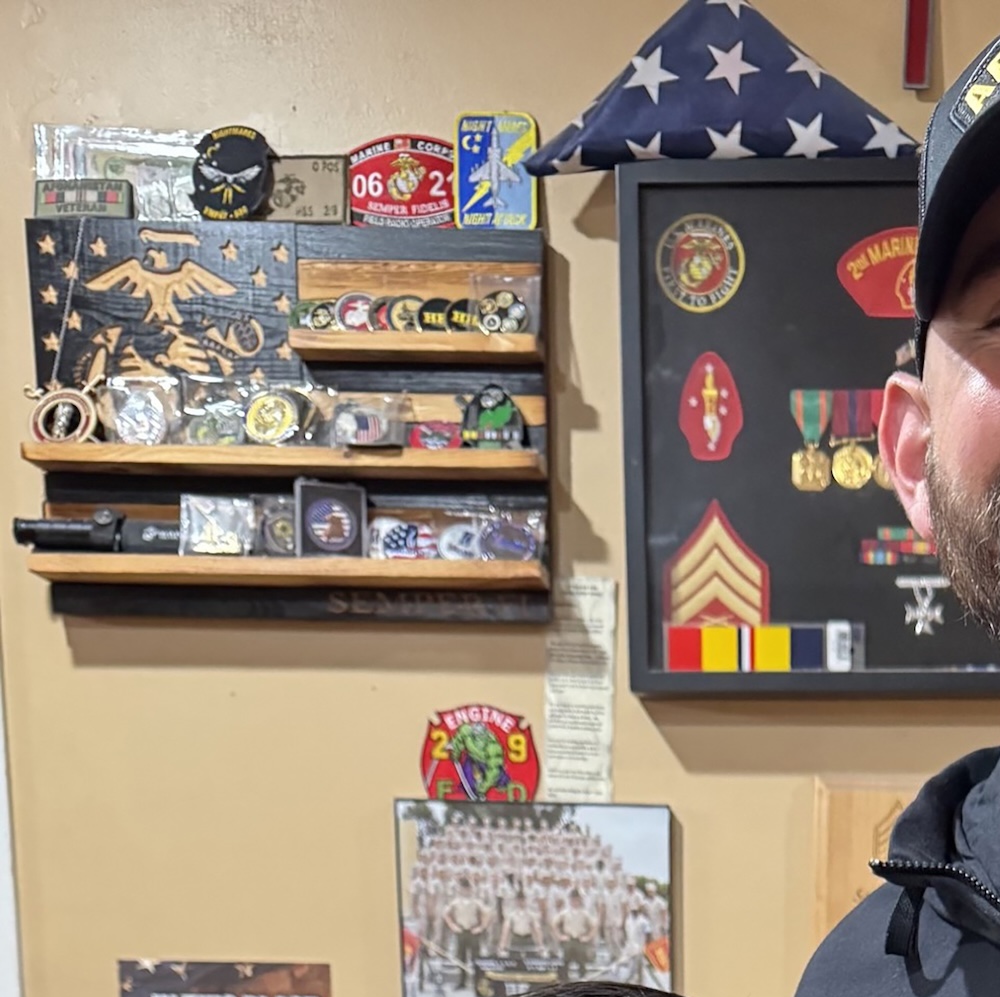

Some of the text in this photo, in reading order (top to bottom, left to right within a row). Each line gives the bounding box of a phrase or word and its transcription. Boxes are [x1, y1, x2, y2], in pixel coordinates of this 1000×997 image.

[350, 142, 391, 164] MARINE
[352, 170, 454, 198] 06 2
[56, 203, 107, 213] VETERAN
[367, 199, 450, 215] SEMPER FIDELIS
[866, 236, 918, 266] MARIN
[444, 707, 517, 734] ENGINE
[430, 729, 449, 760] 2
[507, 732, 527, 763] 9
